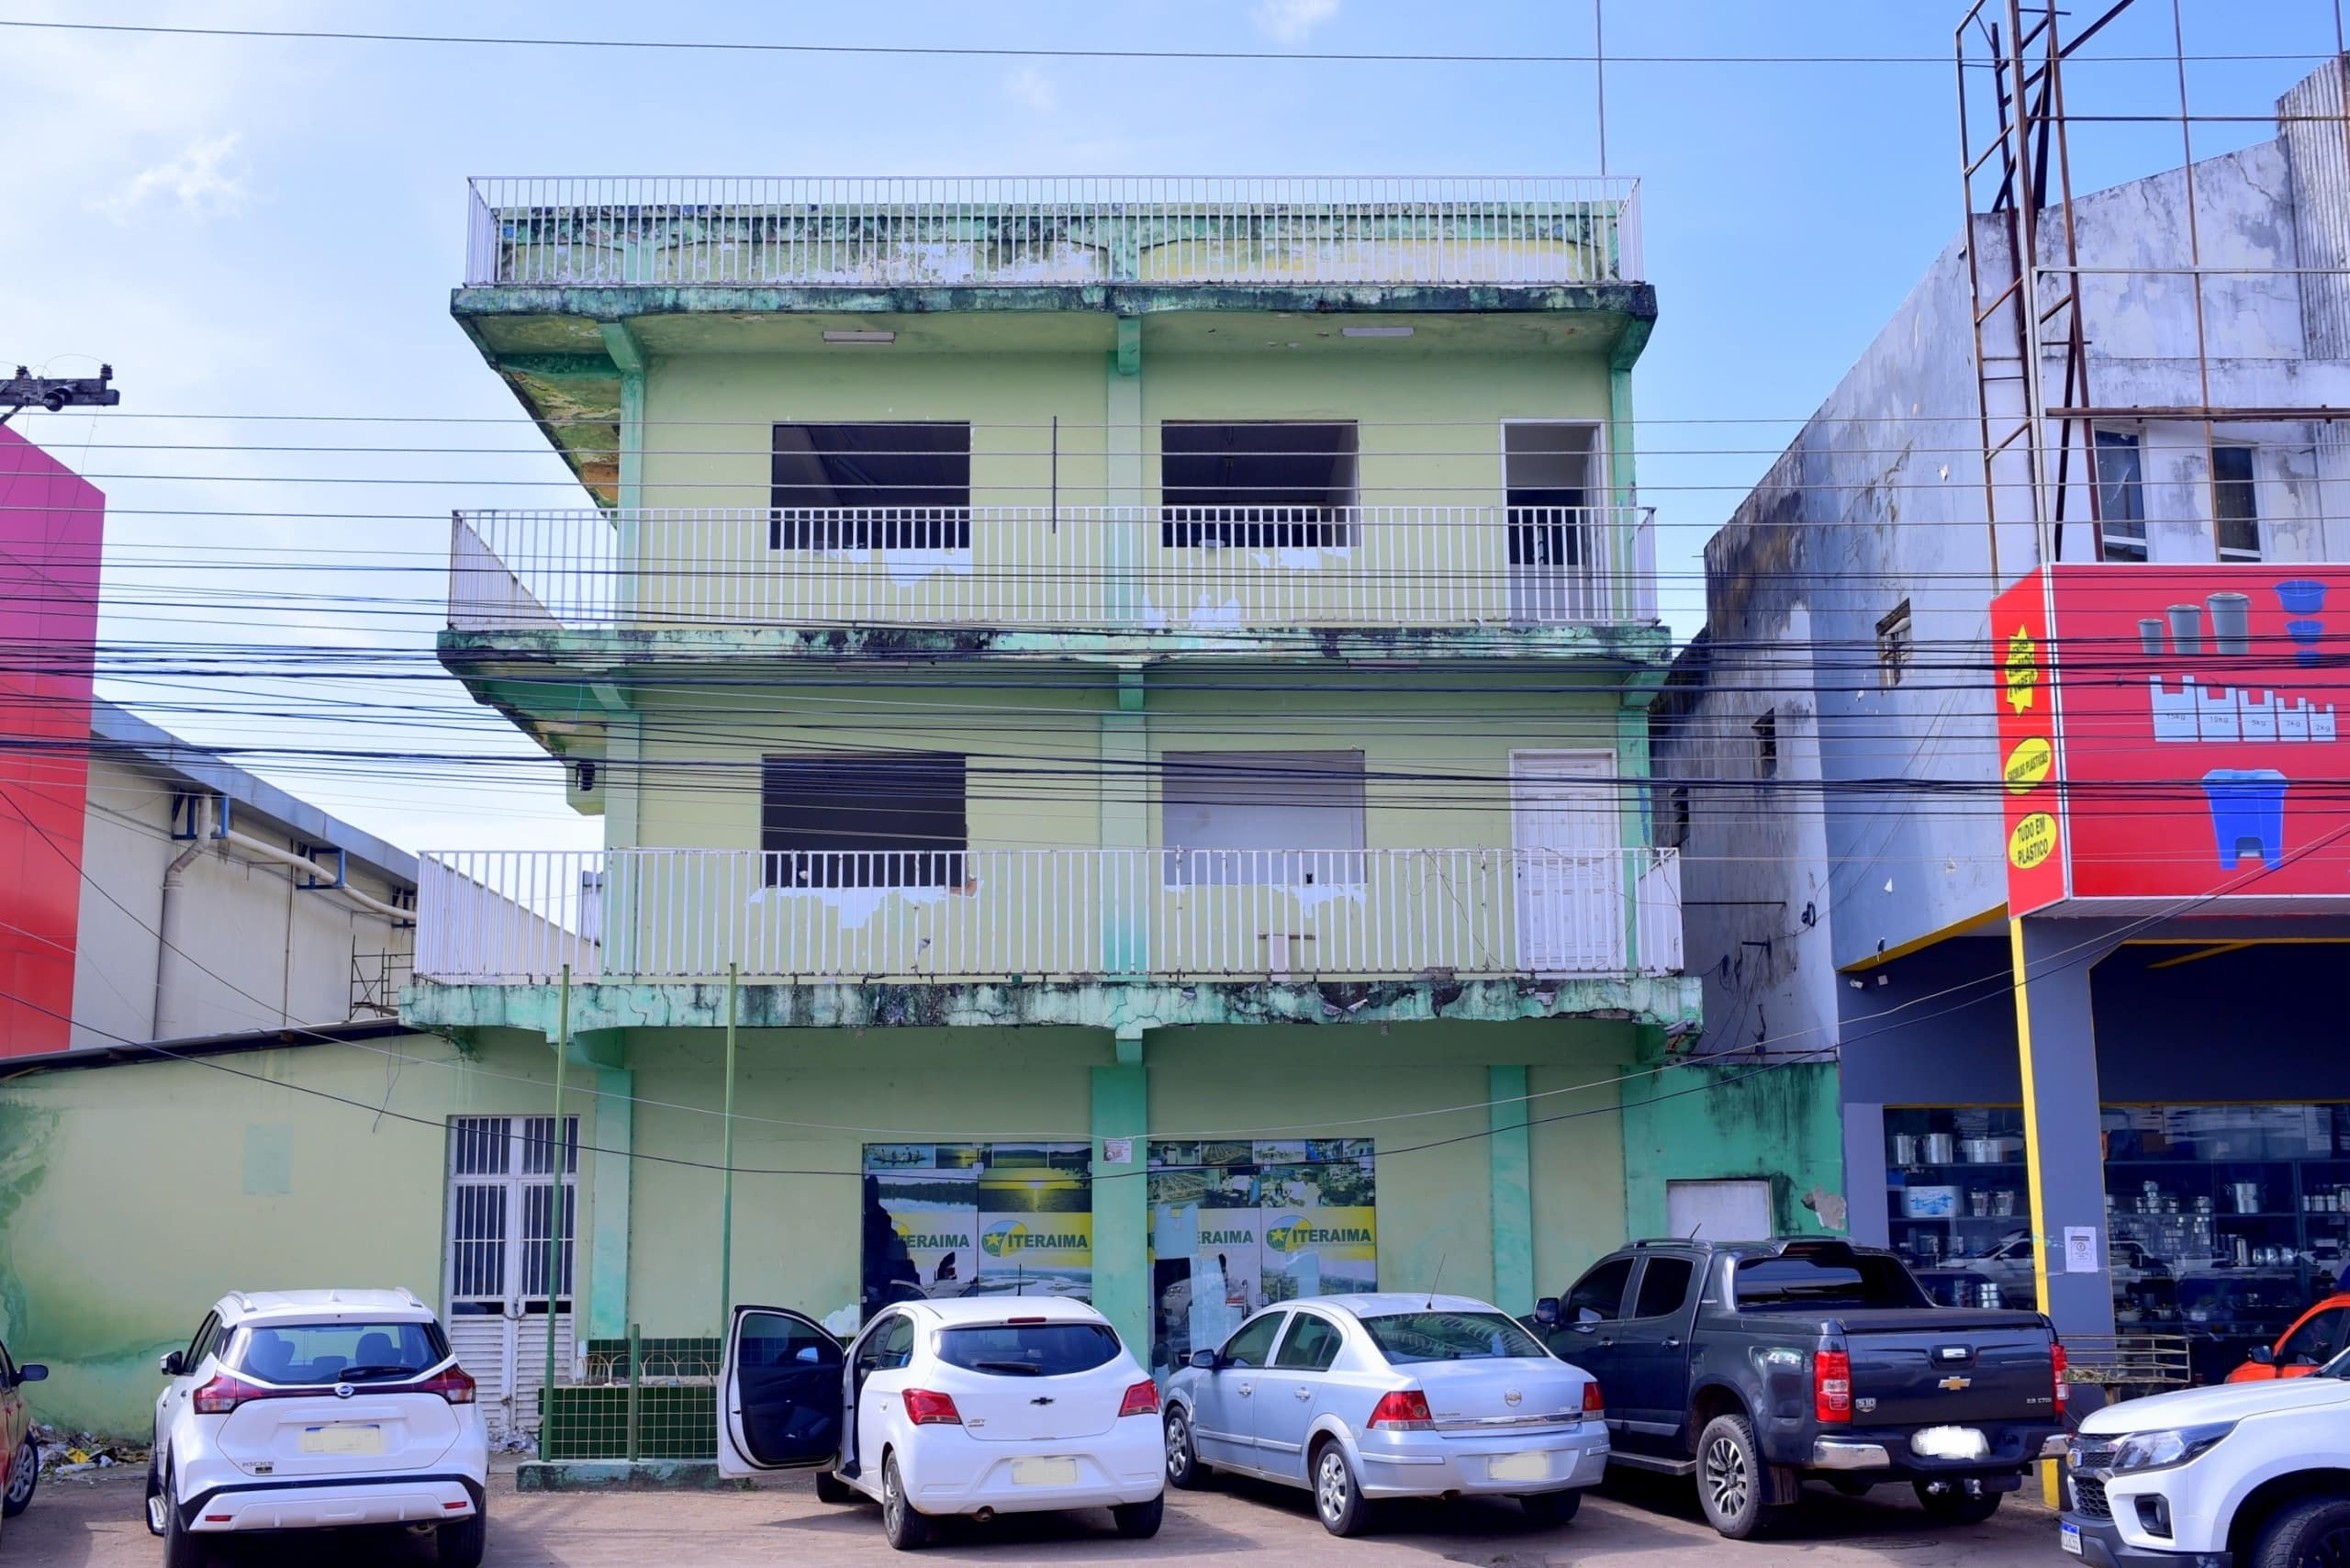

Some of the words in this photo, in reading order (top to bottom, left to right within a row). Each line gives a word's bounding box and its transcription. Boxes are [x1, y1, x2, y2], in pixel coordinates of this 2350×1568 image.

[2251, 719, 2267, 727] 5kg
[2314, 724, 2331, 733] 2kg
[2017, 822, 2034, 843] TUDO
[2035, 815, 2045, 834] EM
[1008, 1234, 1088, 1248] ITERAIMA
[1292, 1228, 1371, 1242] ITERAIMA
